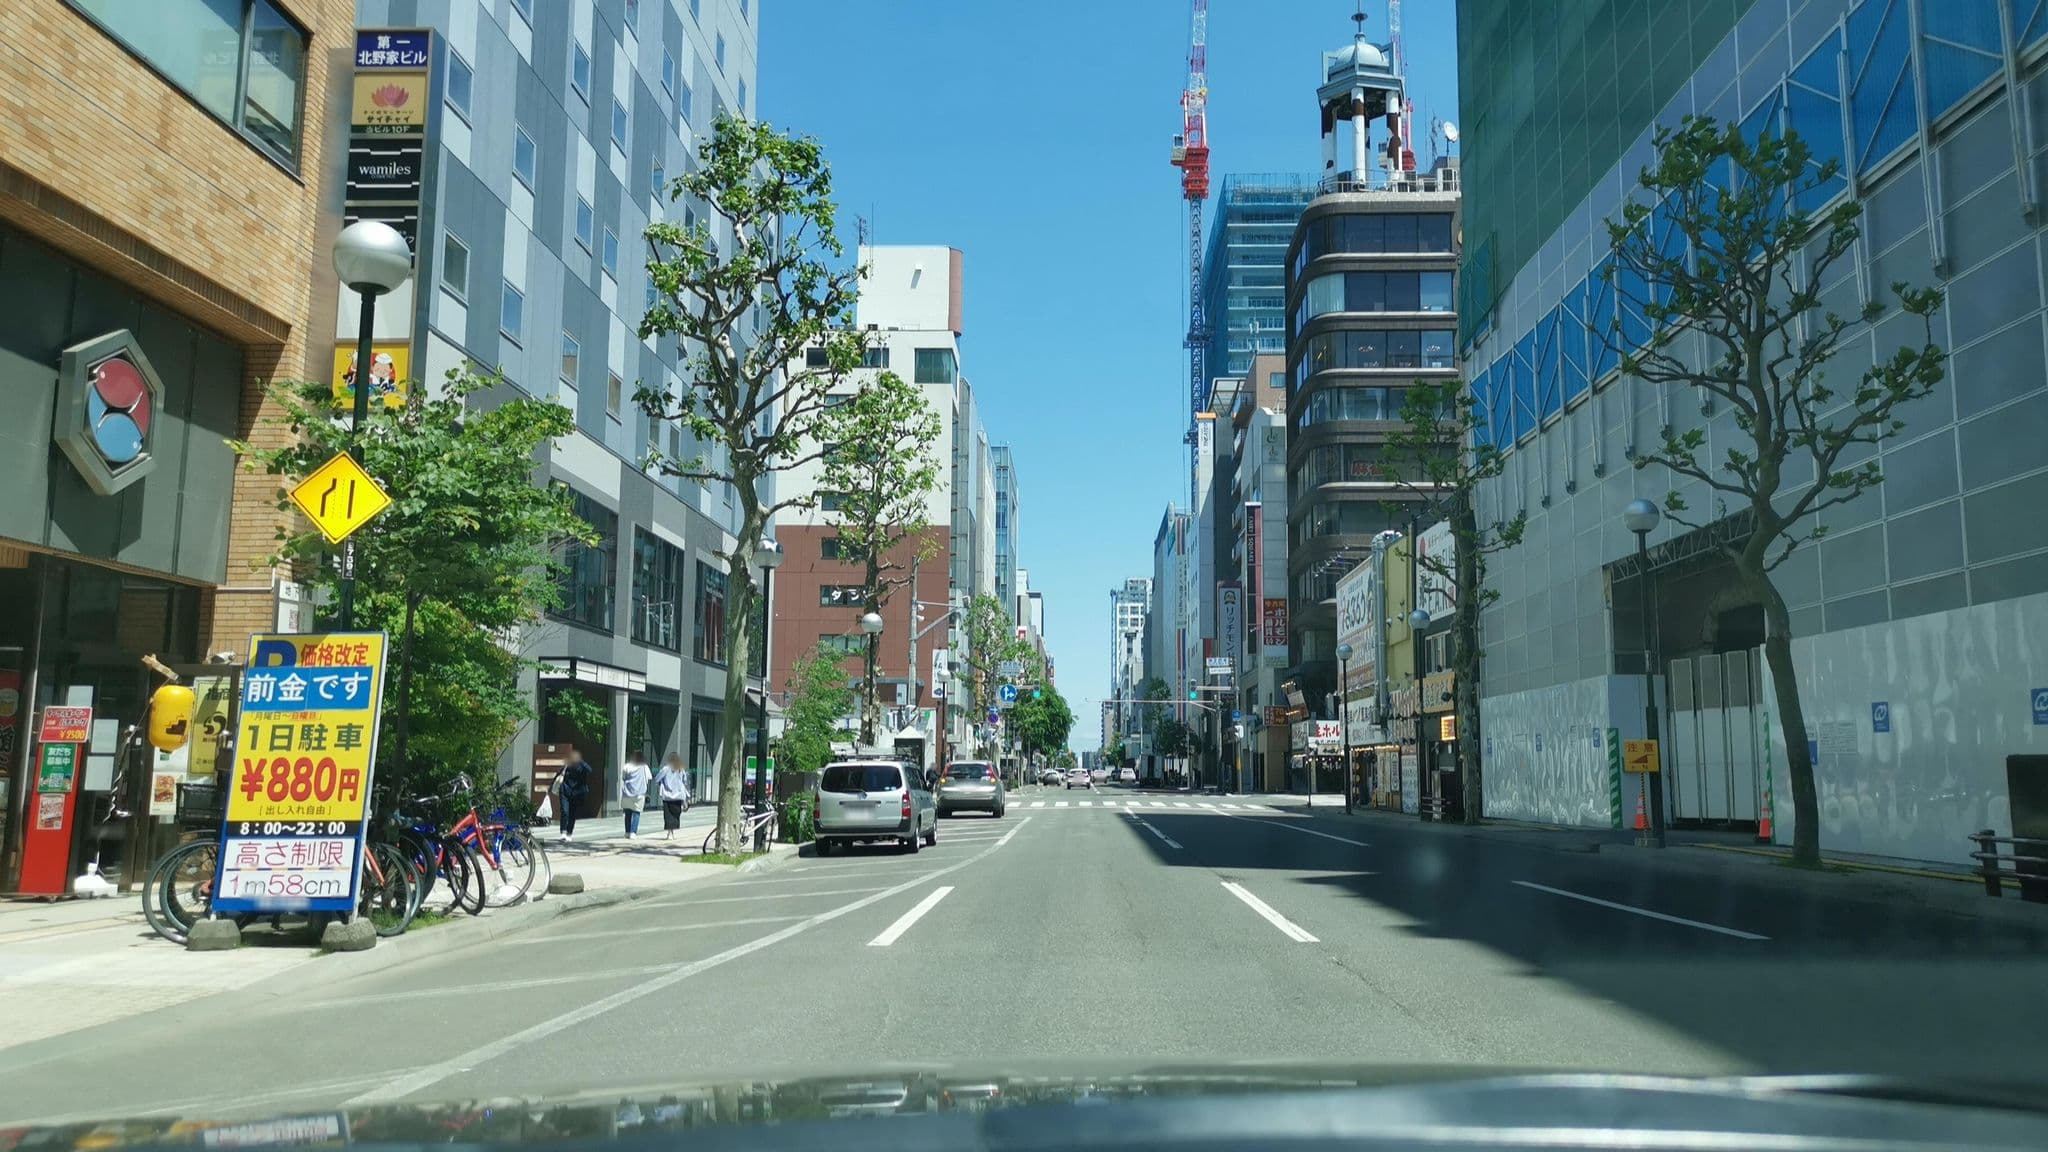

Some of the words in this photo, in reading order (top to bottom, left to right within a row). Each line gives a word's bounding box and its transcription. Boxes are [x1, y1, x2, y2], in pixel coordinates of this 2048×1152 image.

[376, 35, 411, 50] 第一
[358, 50, 427, 65] 北野家ビル
[359, 161, 411, 175] wamiles
[301, 642, 369, 667] 価格改定
[247, 671, 369, 703] 前金です
[248, 723, 364, 751] 1日駐車
[240, 756, 360, 803] ¥880円
[236, 842, 344, 867] 高さ制限
